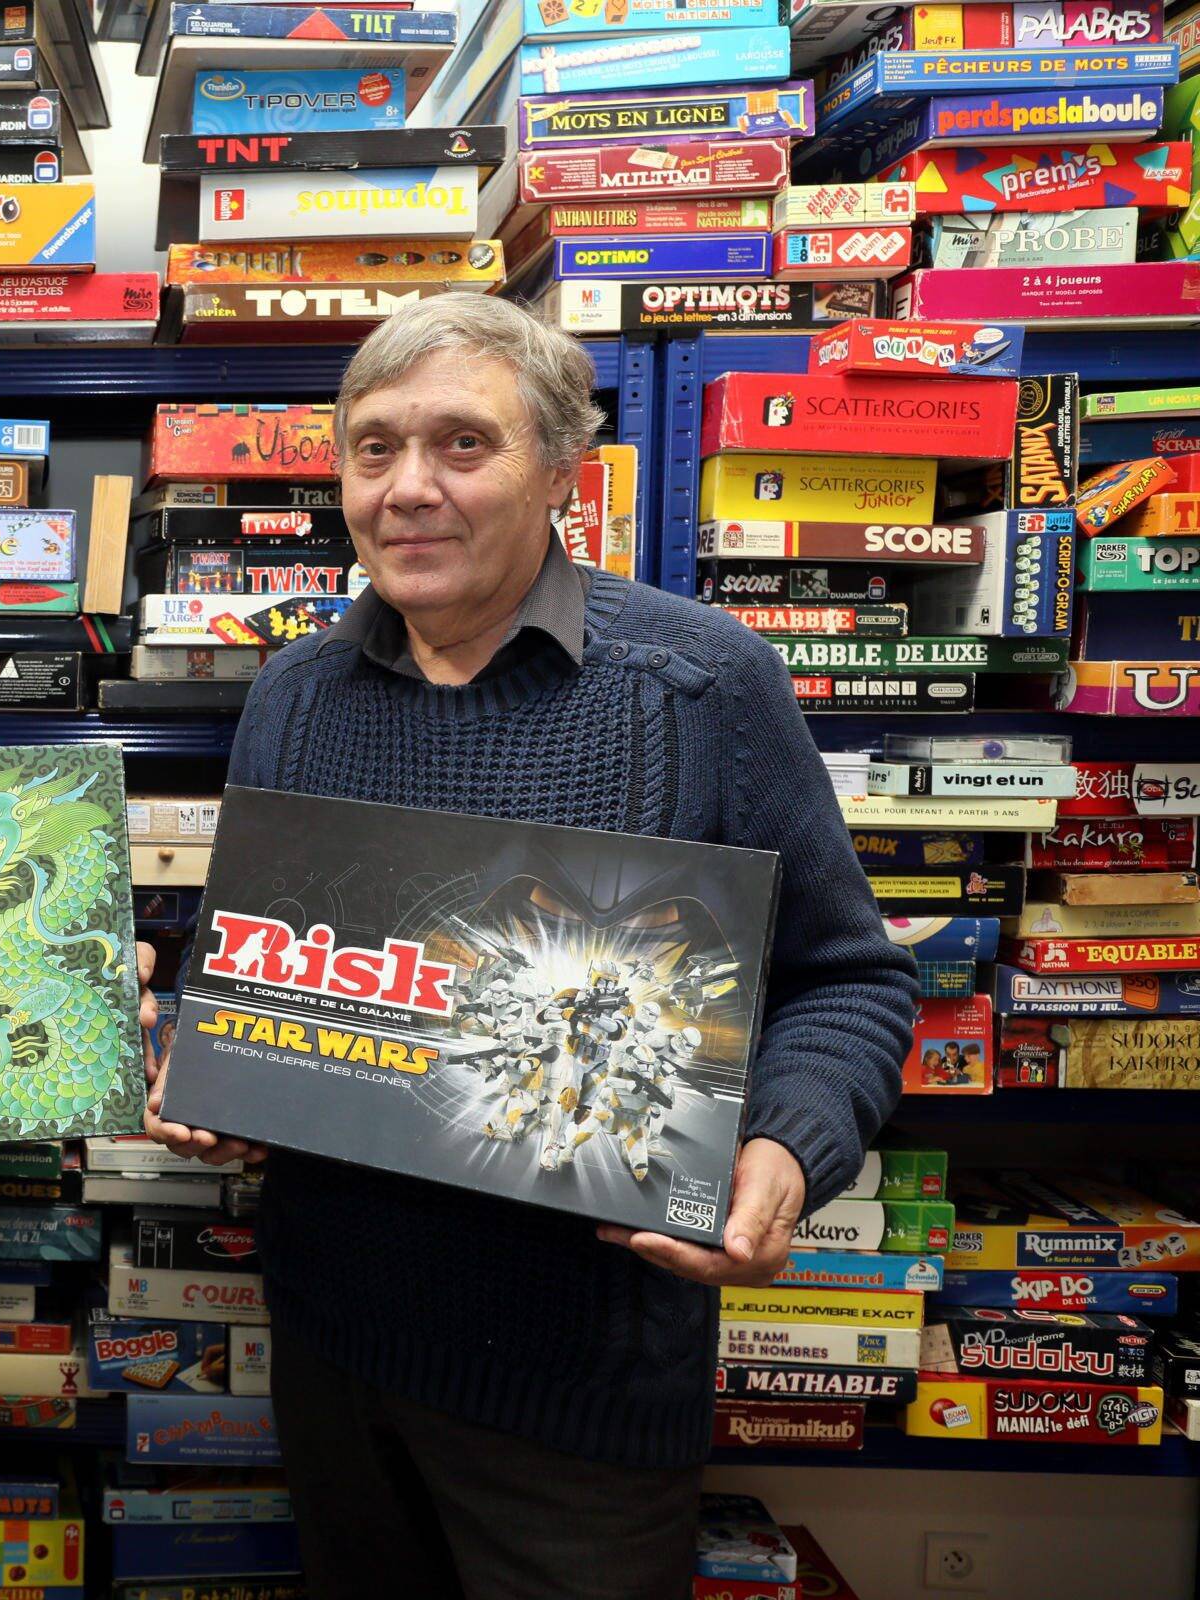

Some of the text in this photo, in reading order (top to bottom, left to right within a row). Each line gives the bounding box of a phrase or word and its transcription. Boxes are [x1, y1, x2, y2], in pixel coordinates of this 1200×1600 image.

[351, 14, 395, 34] TILT
[924, 58, 1128, 74] PÊCHEURS DE MOTS
[552, 106, 726, 130] MOTS EN LIGNE
[198, 138, 288, 163] TNT
[601, 168, 710, 188] MULTIMO
[296, 186, 469, 217] Topminos
[555, 210, 637, 227] NATHAN LETTRES
[41, 208, 94, 260] Ravensburger
[990, 227, 1124, 253] PROBE
[1023, 274, 1102, 287] 2 à 4 joueurs
[642, 284, 790, 311] OPTIMOTS
[805, 397, 981, 421] SCATTERGORIES
[1019, 422, 1067, 504] SATANIX
[799, 477, 925, 494] SCATTERGORIES
[865, 527, 972, 555] SCORE
[719, 574, 783, 593] SCORE
[896, 645, 987, 661] DE LUXE
[943, 773, 1043, 787] vingt et un
[202, 909, 456, 1017] Risk
[236, 983, 412, 1022] LA CONQUÊTE DE LA GALAXIE
[1031, 1004, 1078, 1012] PASSION
[197, 1009, 439, 1075] STAR WARS
[213, 1041, 411, 1089] ÉDITION GUERRE DES CLONES
[670, 1199, 713, 1216] PARKER
[1024, 1233, 1118, 1252] Rummix
[1011, 1276, 1094, 1302] SKIP-BO
[738, 1302, 914, 1319] JEU DU NOMBRE EXACT
[97, 1330, 177, 1360] Boggle
[729, 1330, 788, 1343] LE RAMI
[728, 1343, 828, 1359] DES NOMBRES
[746, 1372, 900, 1396] MATHABLE
[994, 1389, 1092, 1413] SUDOKU
[728, 1416, 855, 1448] Rummikub
[996, 1414, 1050, 1434] MANIA!
